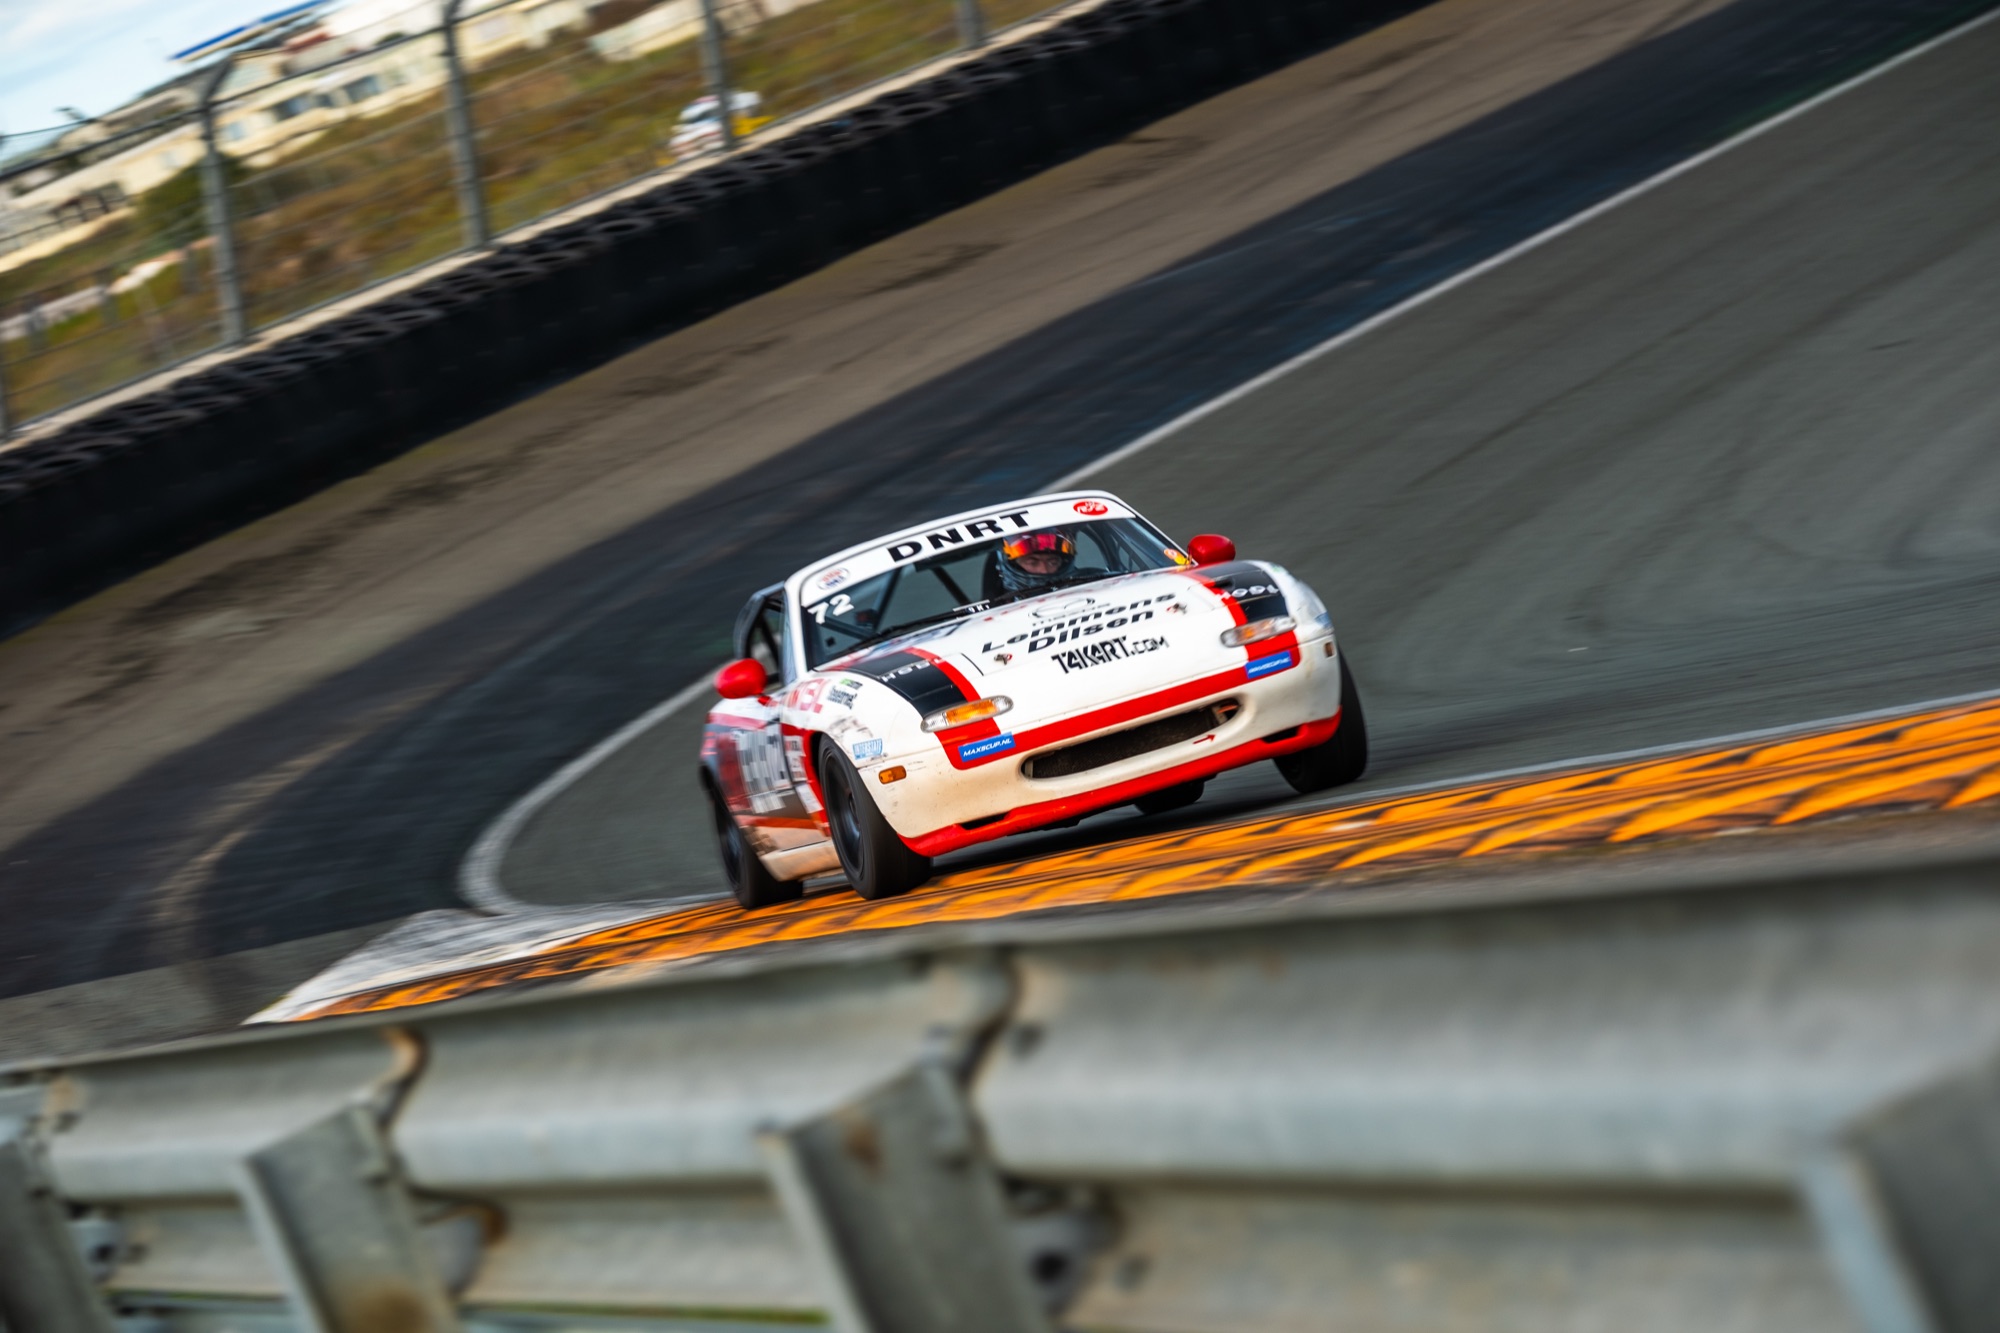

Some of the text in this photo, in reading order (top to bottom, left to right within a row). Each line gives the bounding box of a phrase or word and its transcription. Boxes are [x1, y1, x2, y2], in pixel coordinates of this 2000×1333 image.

[887, 510, 1029, 562] DNRT
[807, 593, 855, 625] 72
[1028, 610, 1154, 654] Dilsen
